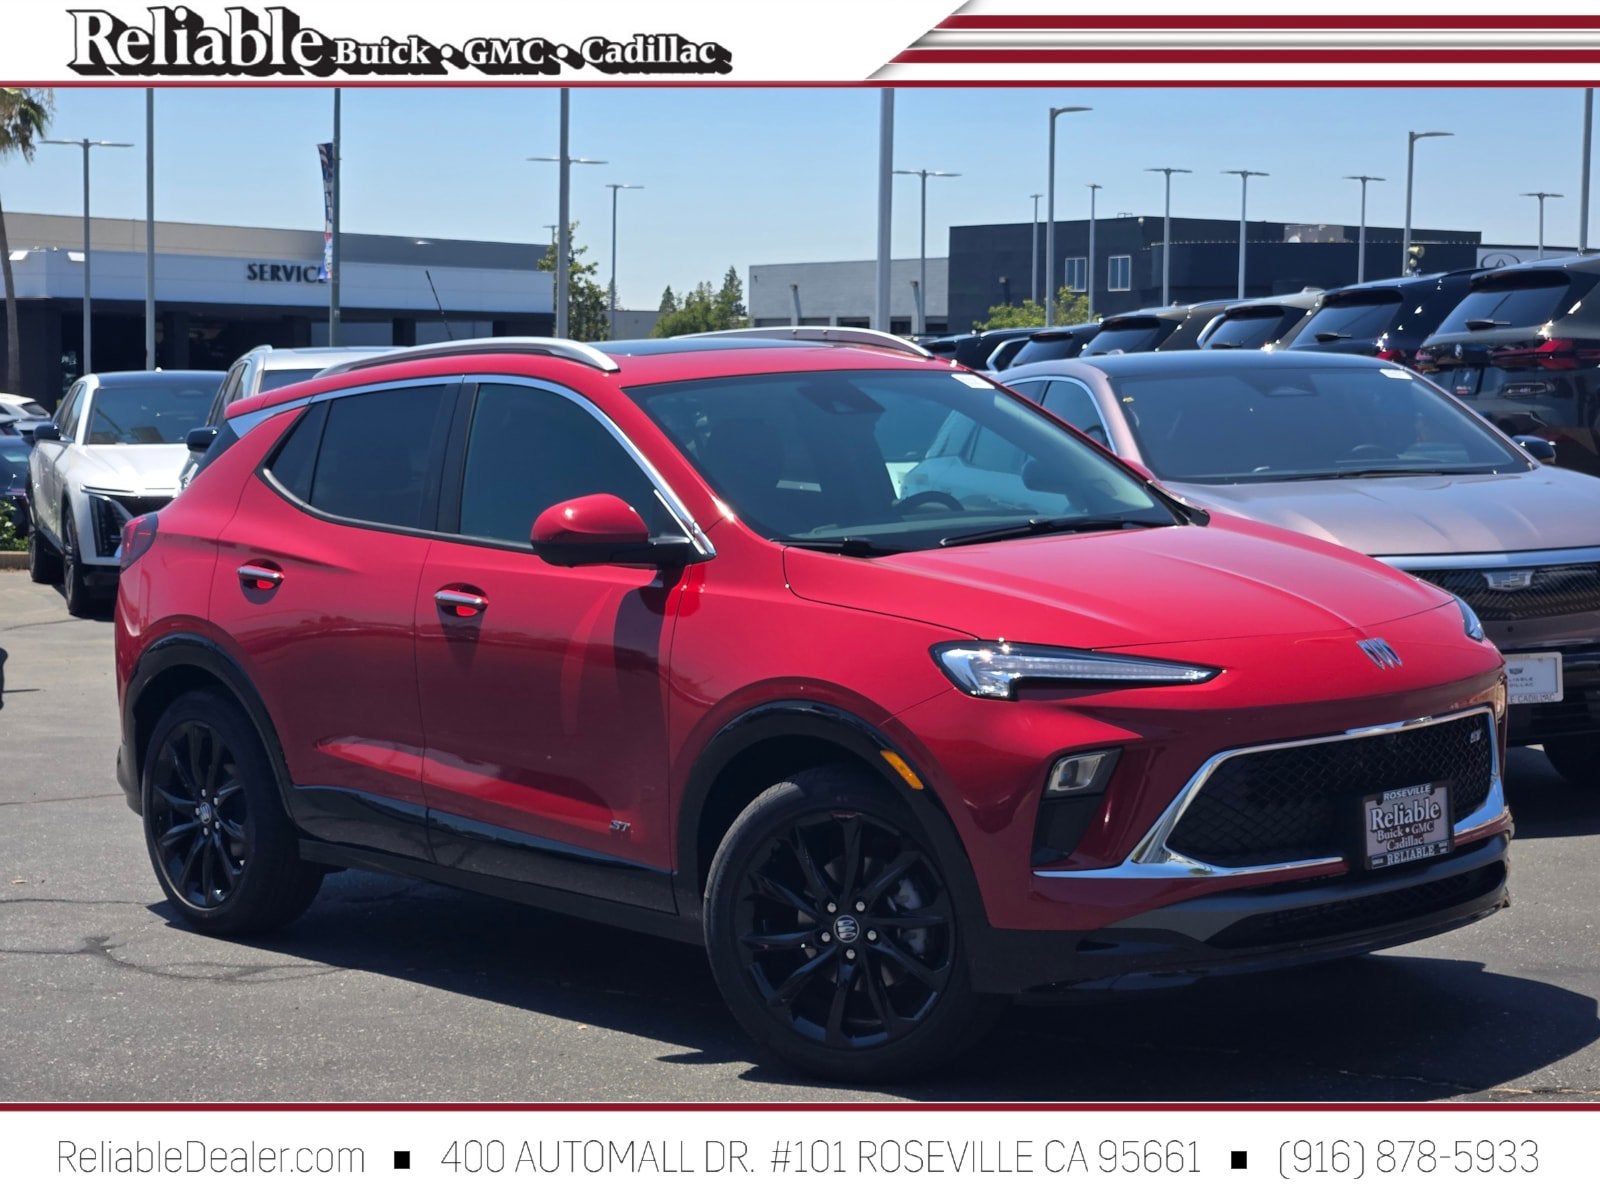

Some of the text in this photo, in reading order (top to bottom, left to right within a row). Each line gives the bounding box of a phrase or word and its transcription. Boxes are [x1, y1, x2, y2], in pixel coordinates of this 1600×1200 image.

[1383, 784, 1431, 801] ROSEVILLE
[1371, 798, 1441, 831] Reliable
[609, 820, 632, 832] ST
[1377, 820, 1435, 842] Buick GMC
[1386, 834, 1425, 851] Cadillac
[1386, 844, 1435, 866] RELIABLE
